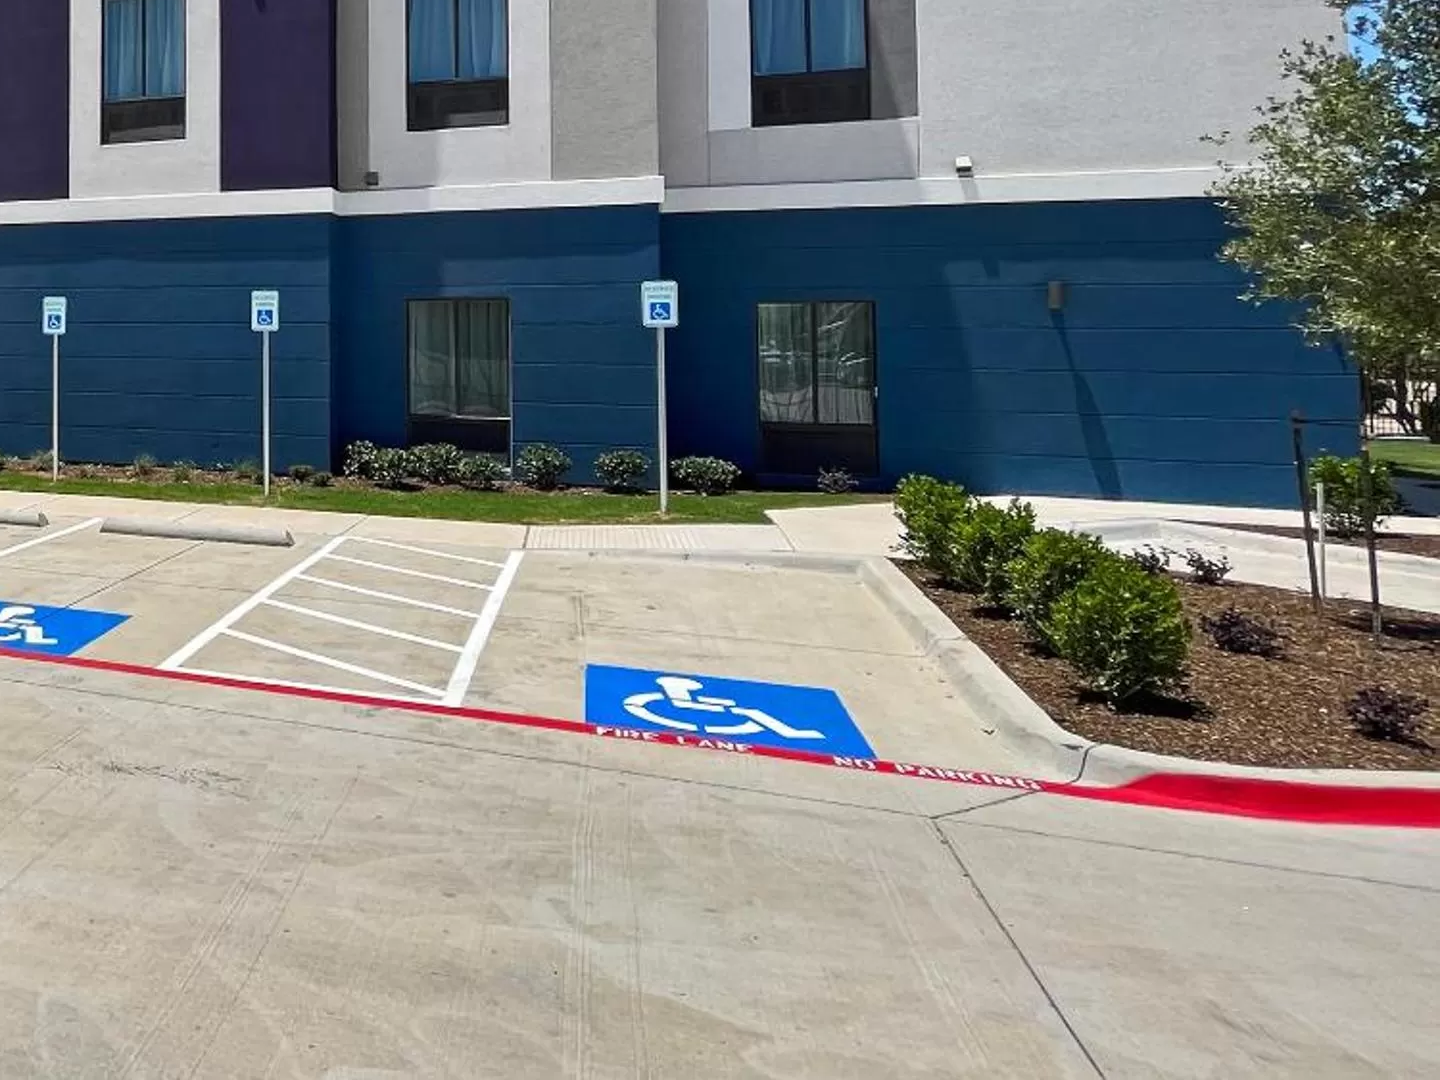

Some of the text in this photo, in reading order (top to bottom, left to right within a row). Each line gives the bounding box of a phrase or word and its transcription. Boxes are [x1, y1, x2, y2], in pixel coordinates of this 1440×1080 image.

[676, 735, 753, 753] LANE
[832, 755, 877, 771] NO
[894, 762, 1042, 791] PARKING
